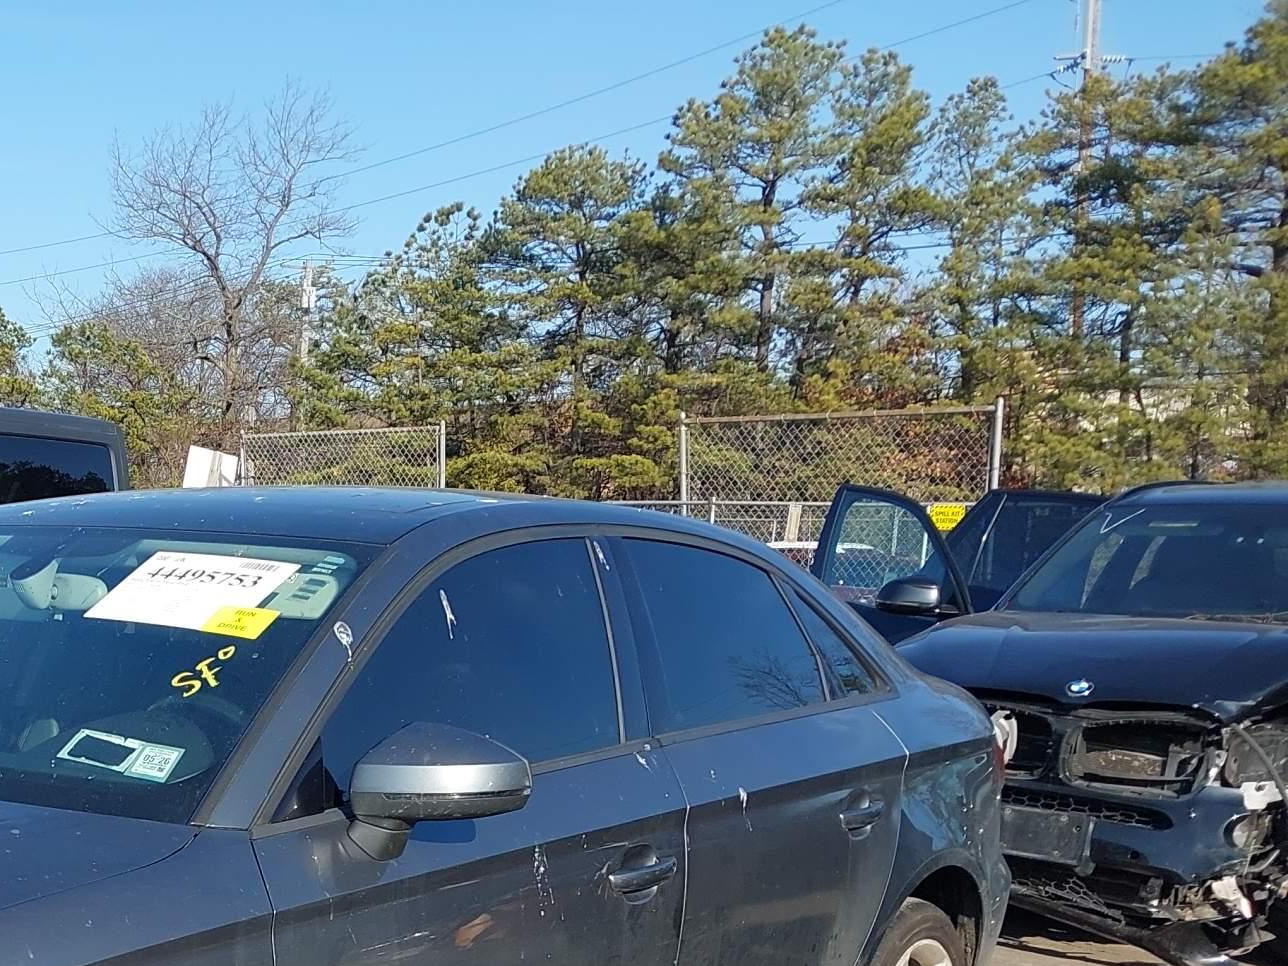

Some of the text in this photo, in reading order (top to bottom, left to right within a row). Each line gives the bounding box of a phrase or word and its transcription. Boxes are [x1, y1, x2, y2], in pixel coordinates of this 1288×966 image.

[147, 565, 263, 588] 44495753
[234, 609, 257, 617] RUN
[216, 621, 248, 632] DRIVE
